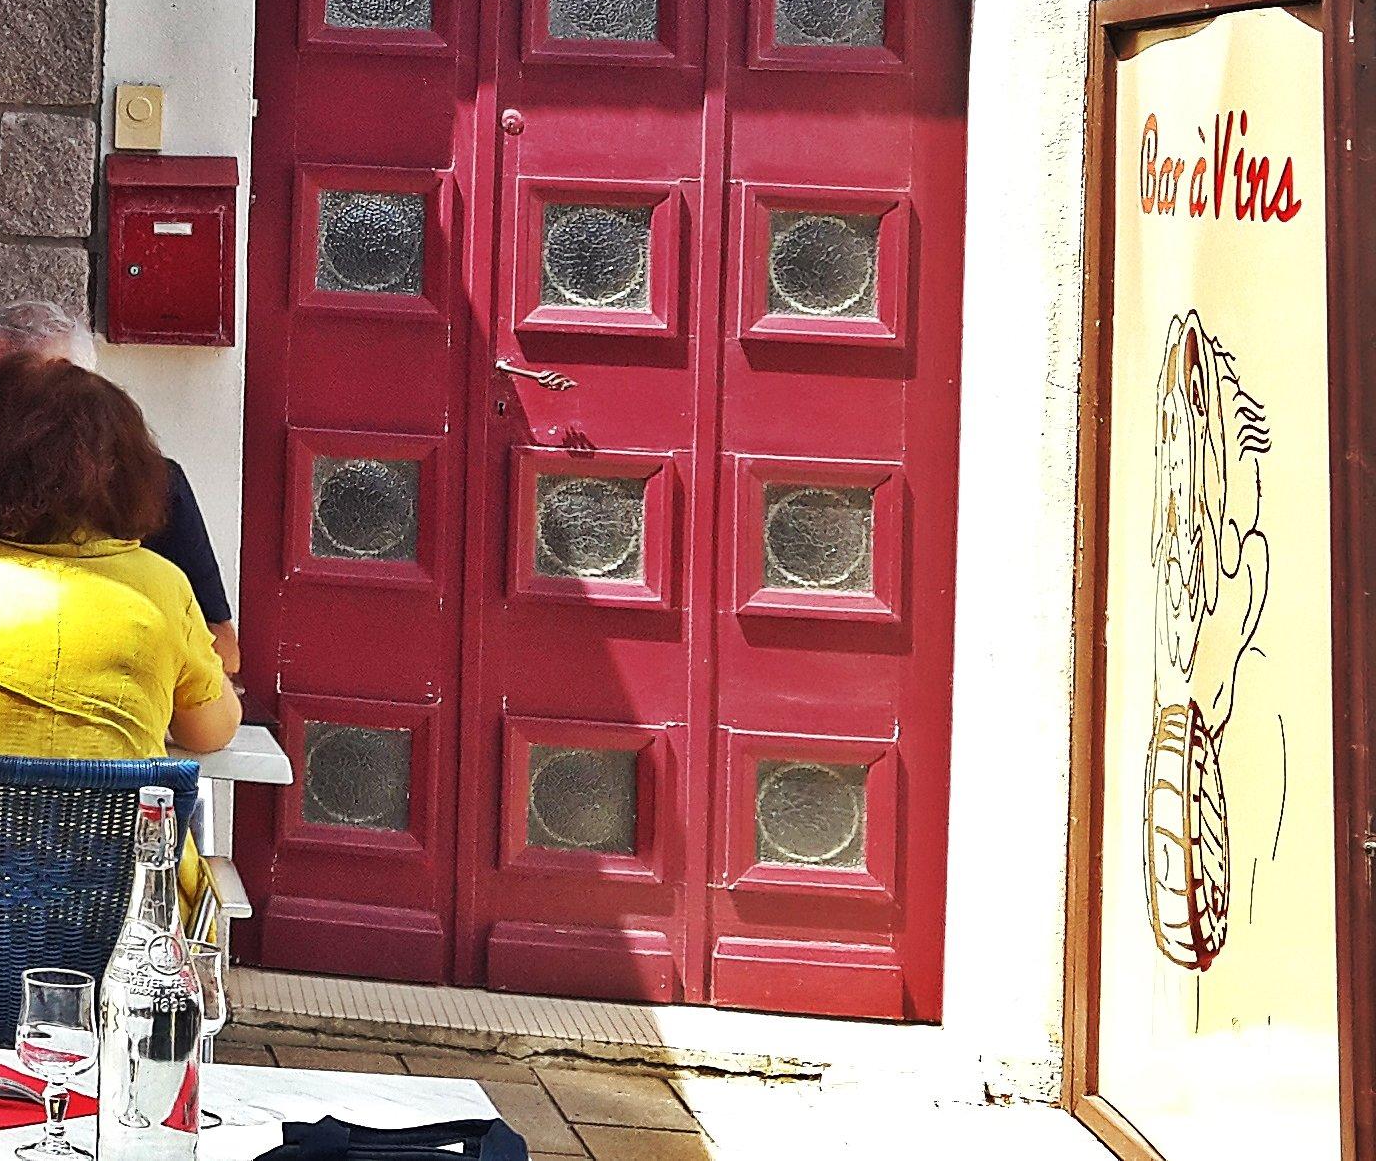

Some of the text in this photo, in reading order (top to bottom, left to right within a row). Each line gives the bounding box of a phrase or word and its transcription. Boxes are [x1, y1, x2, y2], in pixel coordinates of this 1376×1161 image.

[1140, 109, 1302, 223] Bar à Vins
